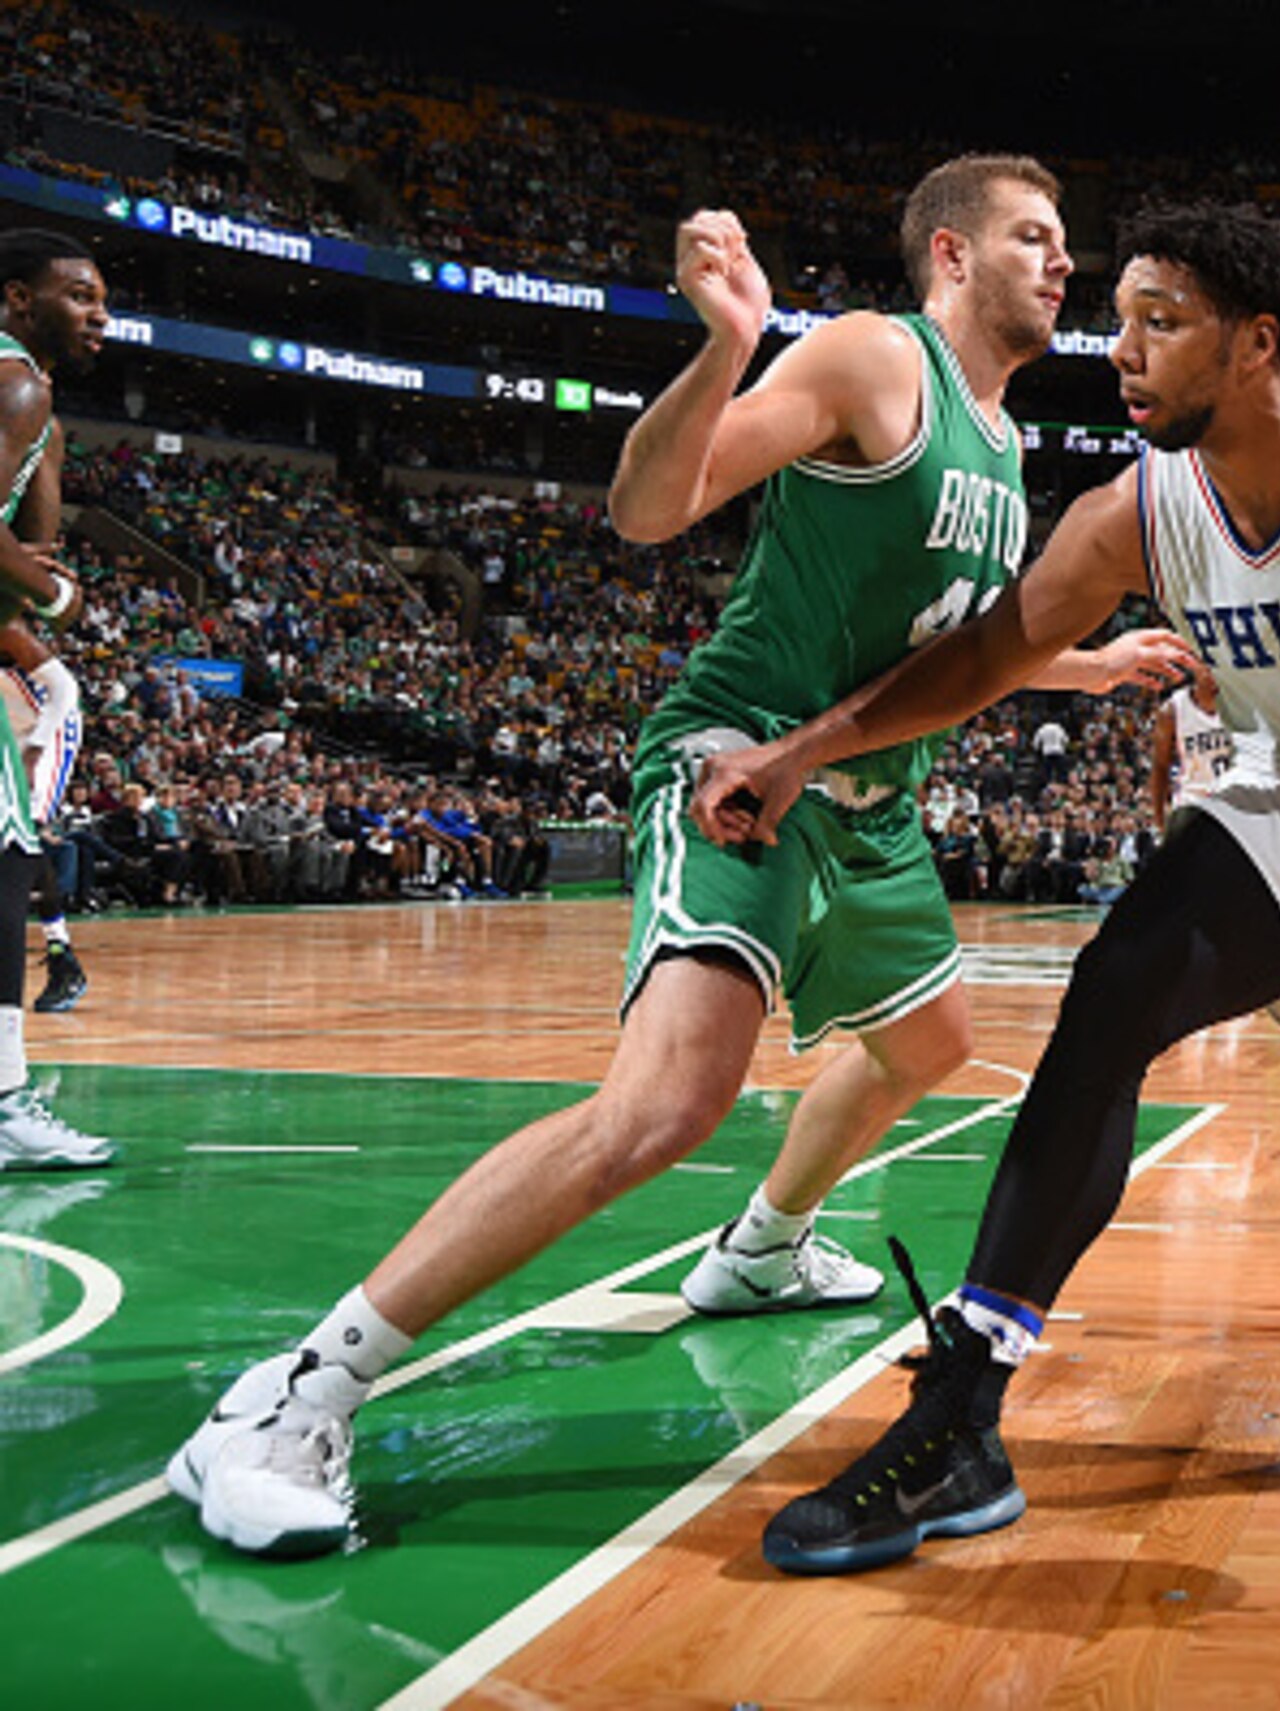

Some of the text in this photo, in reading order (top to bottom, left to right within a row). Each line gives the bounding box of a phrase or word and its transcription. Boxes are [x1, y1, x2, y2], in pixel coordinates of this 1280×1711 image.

[171, 206, 312, 263] Putnam
[472, 266, 604, 311] Putnam
[1051, 330, 1119, 355] utna
[305, 347, 423, 388] Putnam
[486, 374, 544, 402] 9:43
[925, 469, 1028, 577] BOSTO
